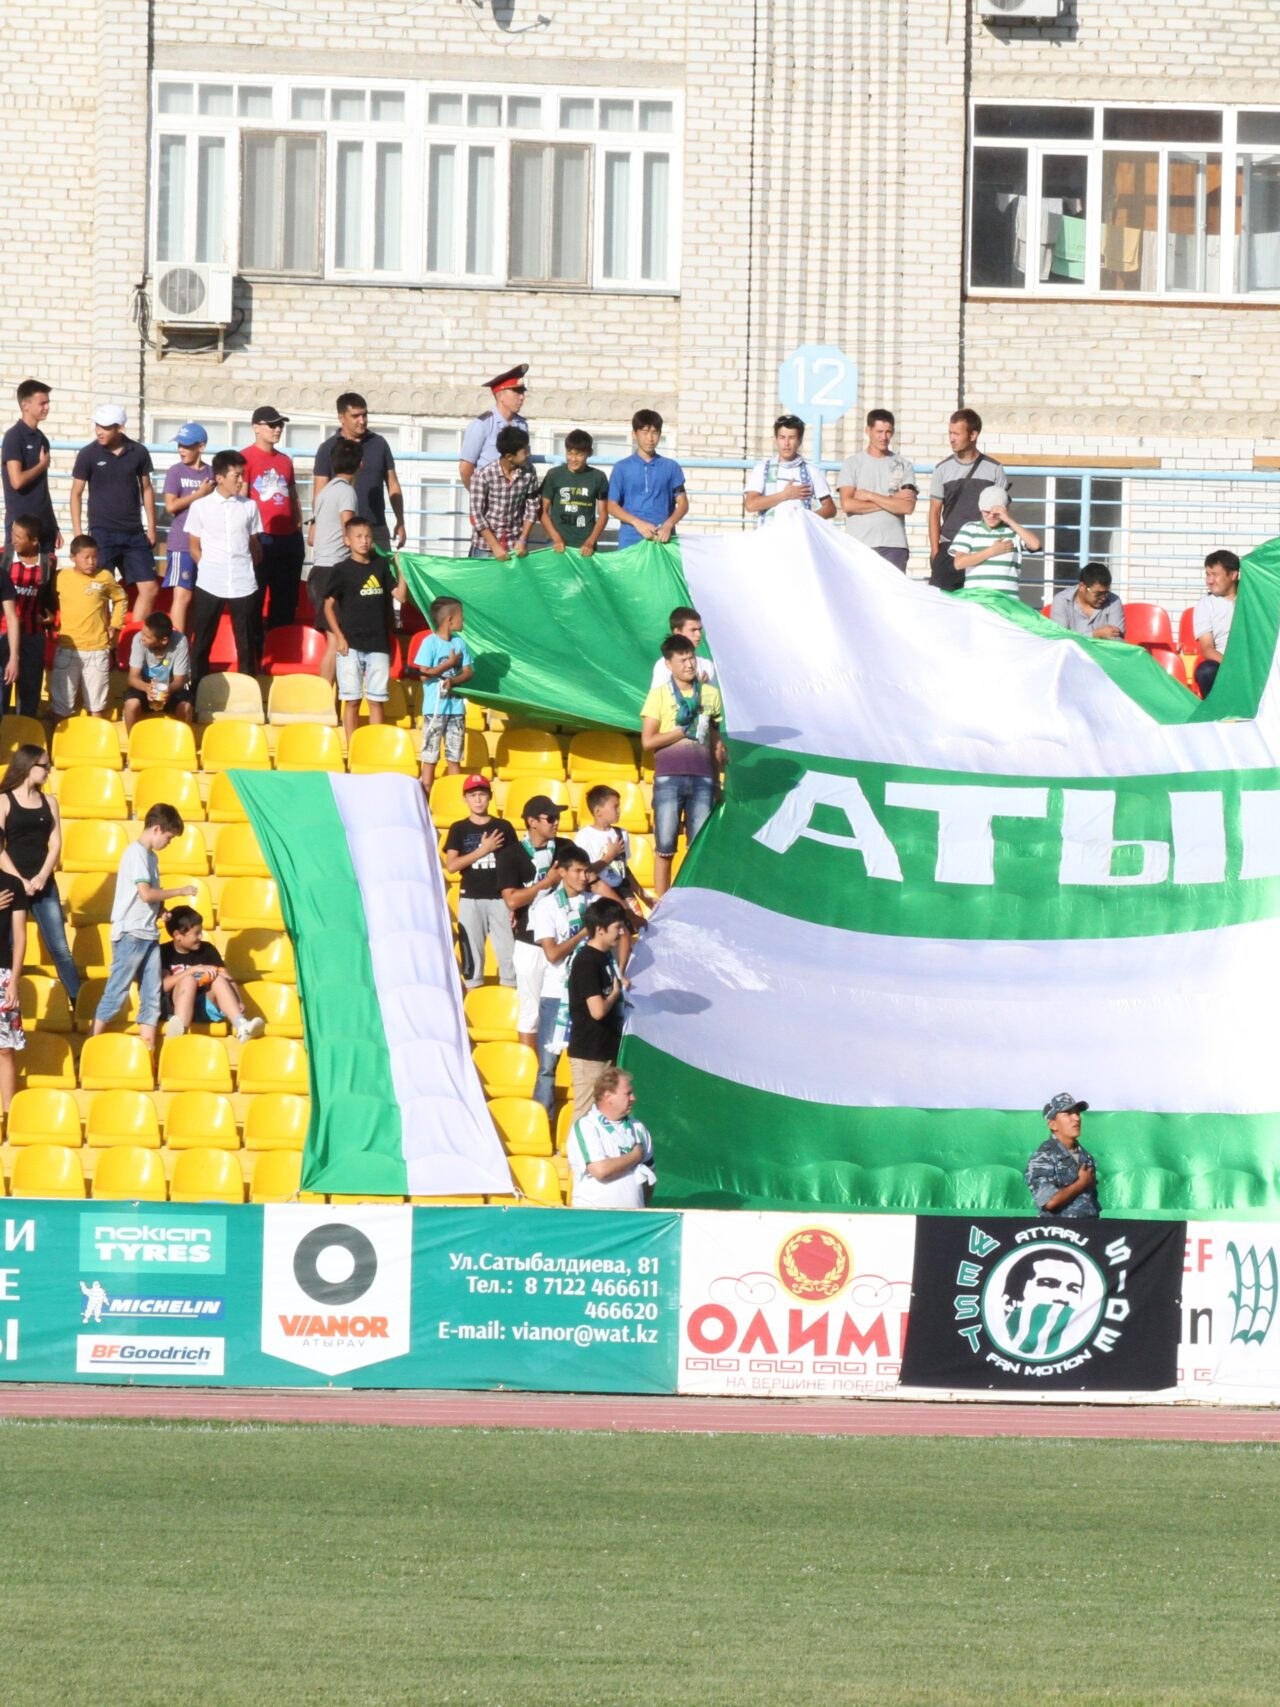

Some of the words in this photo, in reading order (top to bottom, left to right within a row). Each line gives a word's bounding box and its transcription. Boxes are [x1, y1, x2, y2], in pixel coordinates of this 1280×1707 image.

[792, 356, 846, 406] 12
[560, 486, 589, 502] STAR
[94, 1243, 212, 1263] TYRES
[449, 1252, 632, 1277] Ул.Сатыбалдиева,
[637, 1257, 660, 1274] 81
[466, 1276, 514, 1294] Тел.:
[524, 1277, 538, 1295] 8
[543, 1277, 586, 1296] 7122
[591, 1279, 659, 1297] 466611
[109, 1299, 221, 1314] MICHELIN
[584, 1301, 659, 1321] 466620
[278, 1314, 390, 1338] VIANOR
[438, 1320, 506, 1340] E-mail:
[511, 1321, 659, 1347] vianor@wat.kz
[686, 1303, 909, 1359] ОЛИМ
[91, 1344, 211, 1361] BFGoodrich
[302, 1338, 366, 1348] АТЫРАУ
[985, 1352, 1021, 1374] FAN
[1023, 1348, 1093, 1377] MOTION
[725, 1376, 746, 1389] НА
[751, 1377, 827, 1391] ВЕРШИНЕ
